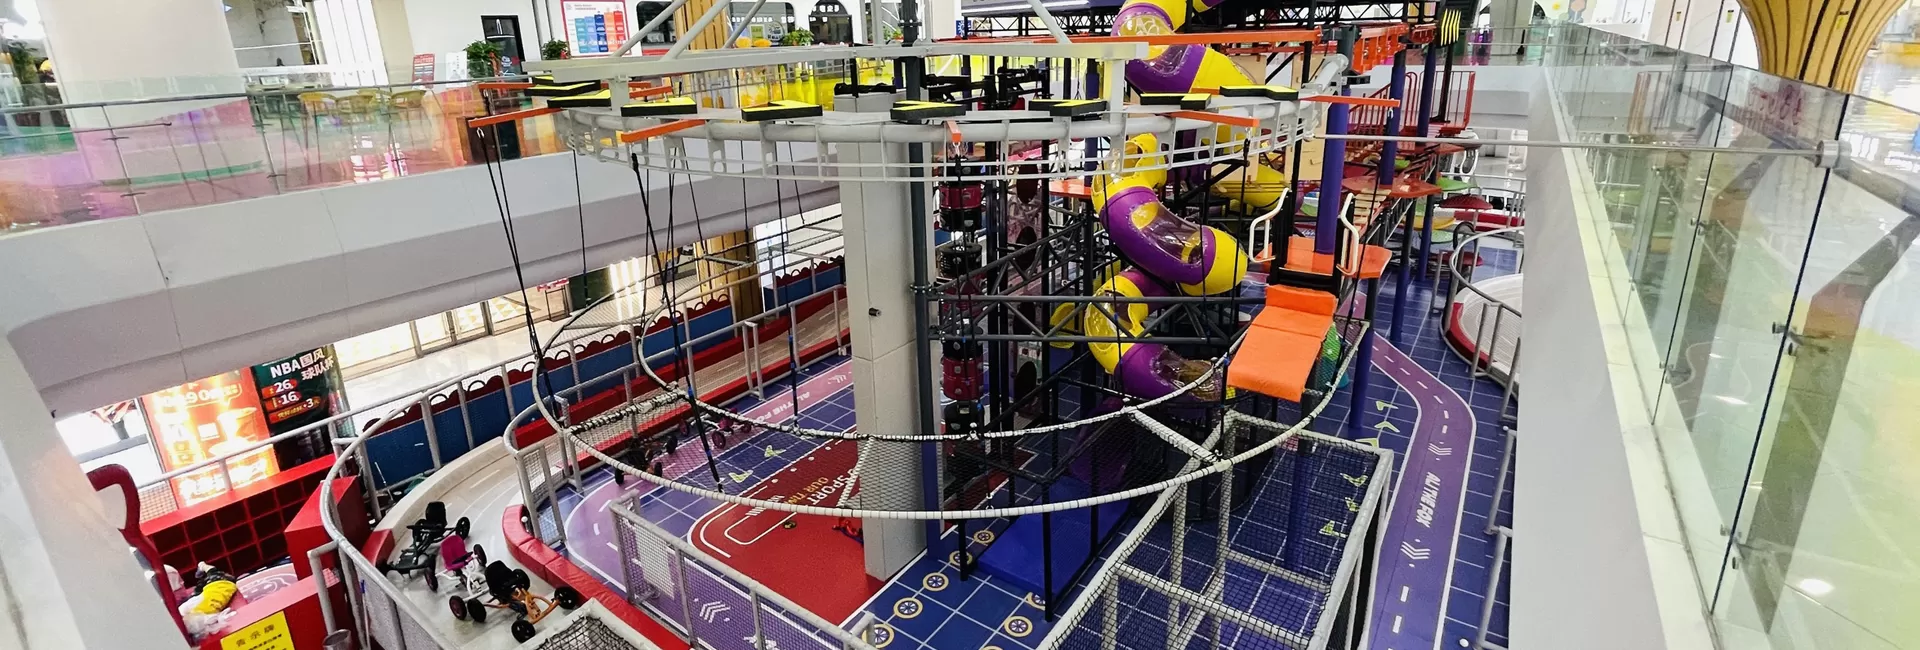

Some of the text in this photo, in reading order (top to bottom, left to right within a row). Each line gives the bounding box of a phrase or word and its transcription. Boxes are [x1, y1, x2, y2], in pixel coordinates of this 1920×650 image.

[773, 401, 794, 414] THE
[806, 477, 829, 496] OUR
[808, 475, 848, 505] SPORT
[1415, 472, 1441, 528] ALI THE FOX
